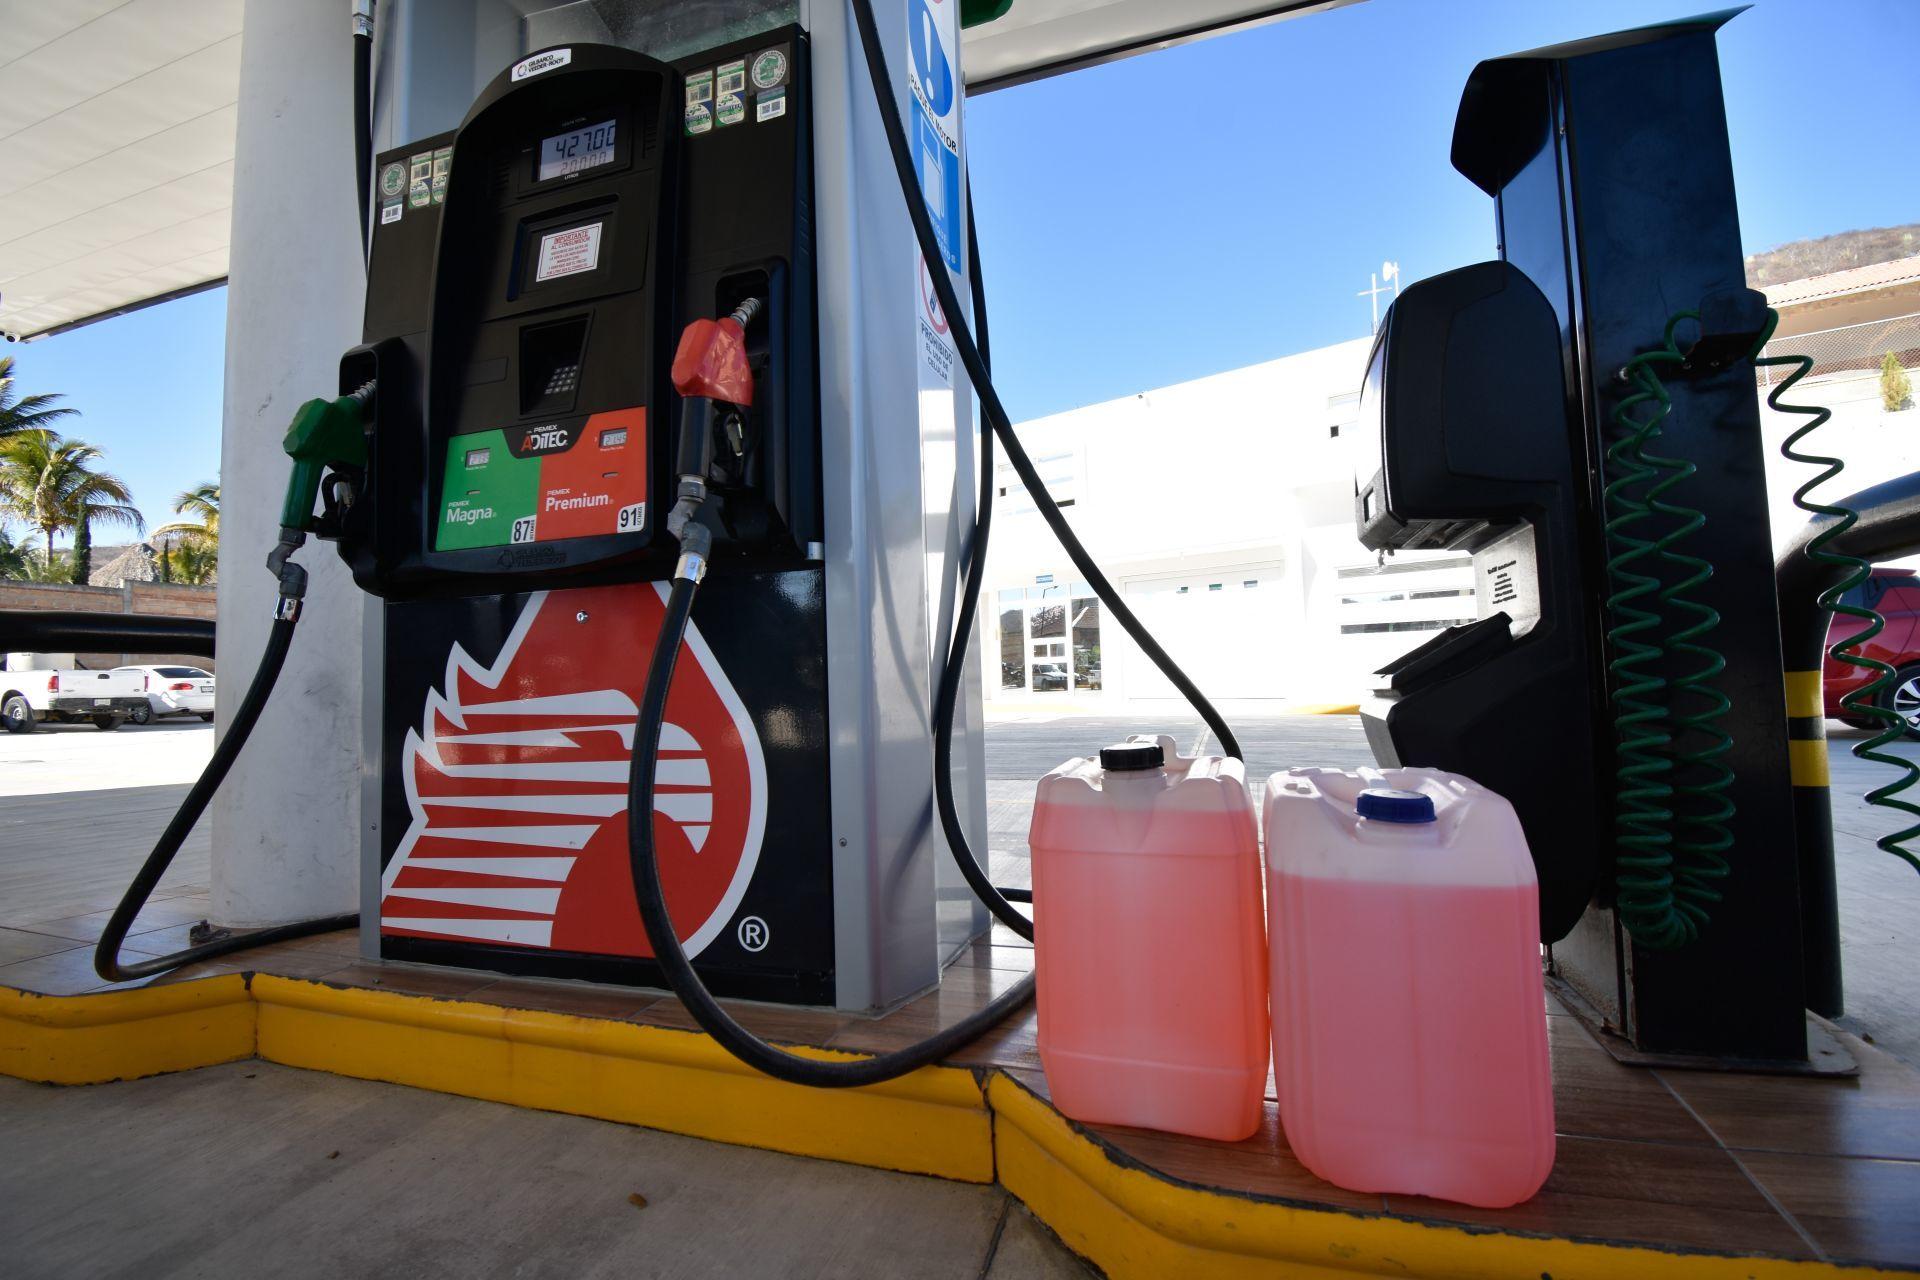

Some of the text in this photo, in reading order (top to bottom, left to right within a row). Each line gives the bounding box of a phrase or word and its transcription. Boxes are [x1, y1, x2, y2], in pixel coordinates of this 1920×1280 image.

[528, 54, 554, 67] GILBARCO
[528, 57, 565, 73] VEEDER-ROOT
[935, 119, 957, 153] MOTOR
[921, 322, 953, 365] PROHIBIDO
[925, 342, 949, 373] EL USO DE
[927, 356, 948, 381] CELULAR
[533, 424, 558, 433] PEMEX
[546, 488, 571, 496] PEMEX
[545, 493, 609, 512] Premium
[446, 507, 493, 525] Magna
[620, 507, 637, 528] 91
[513, 520, 531, 542] 87
